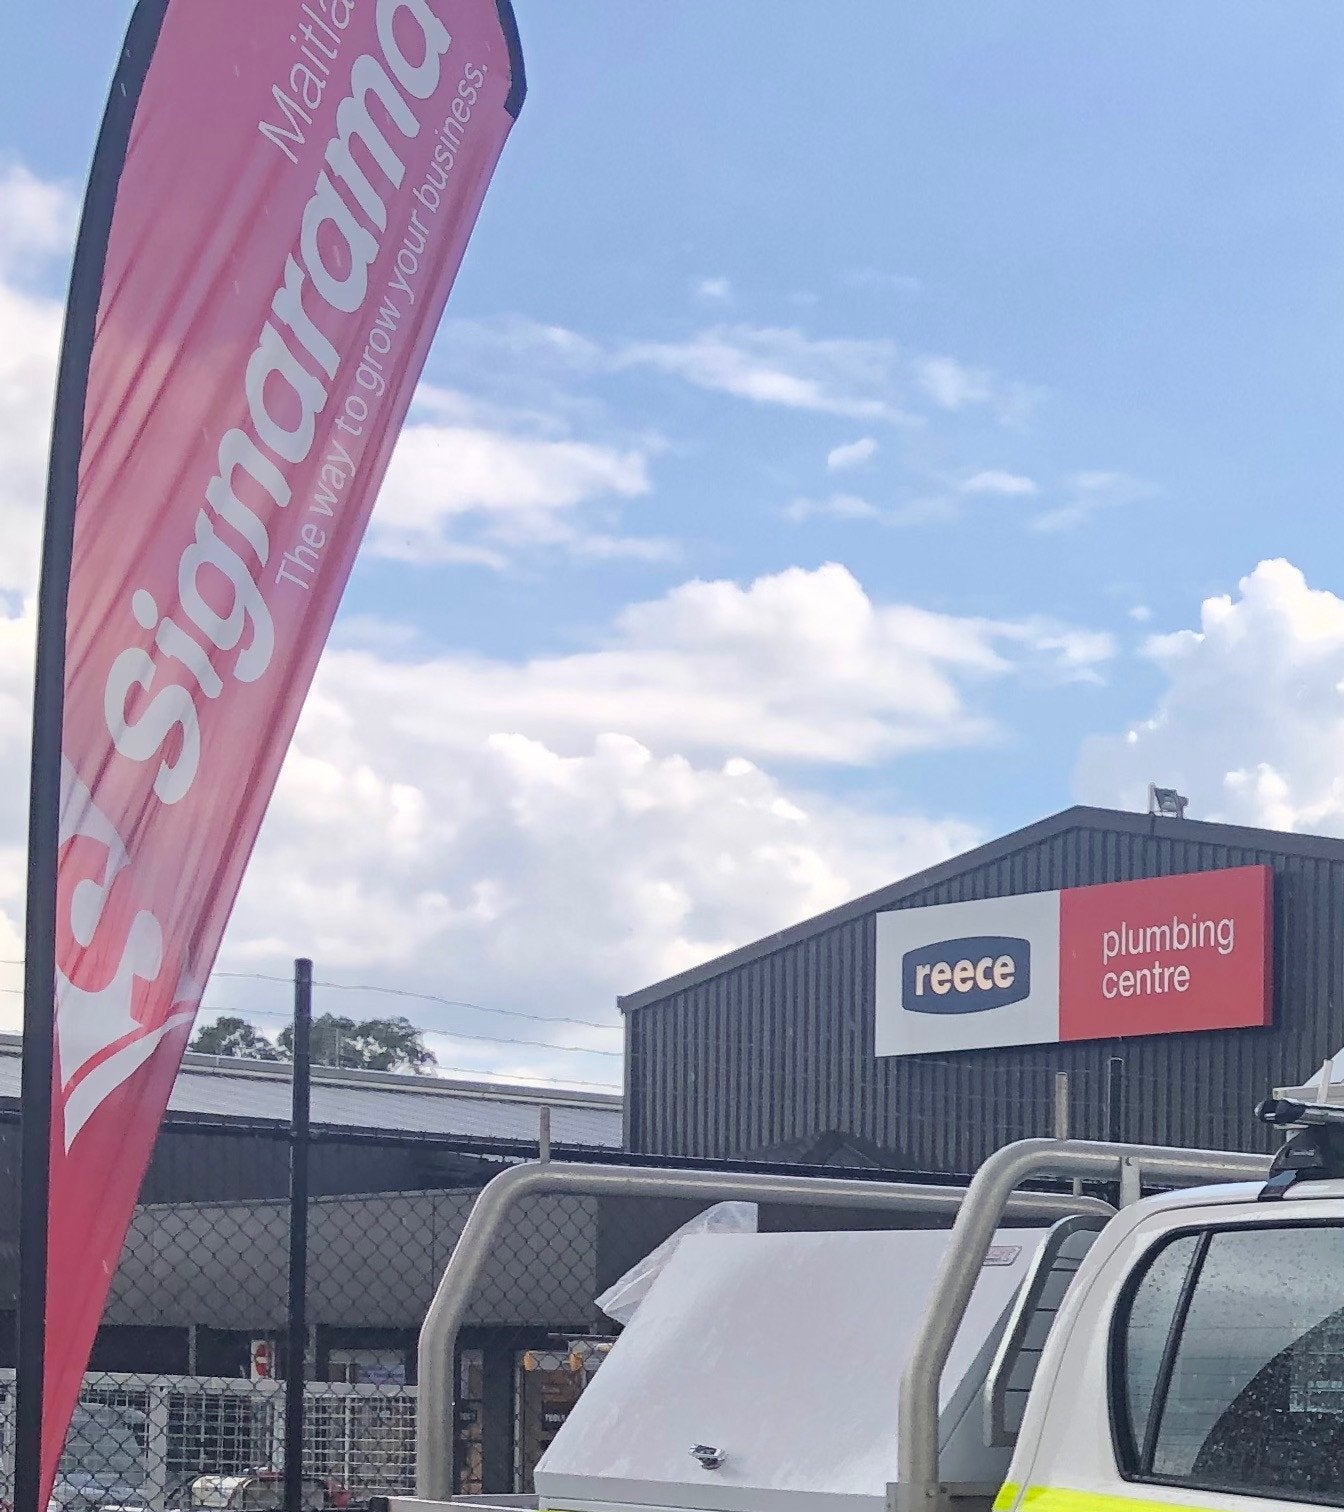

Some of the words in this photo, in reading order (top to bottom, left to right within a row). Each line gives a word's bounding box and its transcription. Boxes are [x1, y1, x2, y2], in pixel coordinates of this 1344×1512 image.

[274, 523, 326, 590] The
[309, 438, 356, 517] way
[334, 394, 368, 436] to
[355, 296, 401, 397] grow
[388, 208, 430, 305] your
[412, 62, 488, 214] business.
[104, 0, 452, 804] Signarama
[1102, 913, 1235, 965] plumbing
[914, 954, 1016, 997] reece
[1101, 961, 1191, 1000] centre
